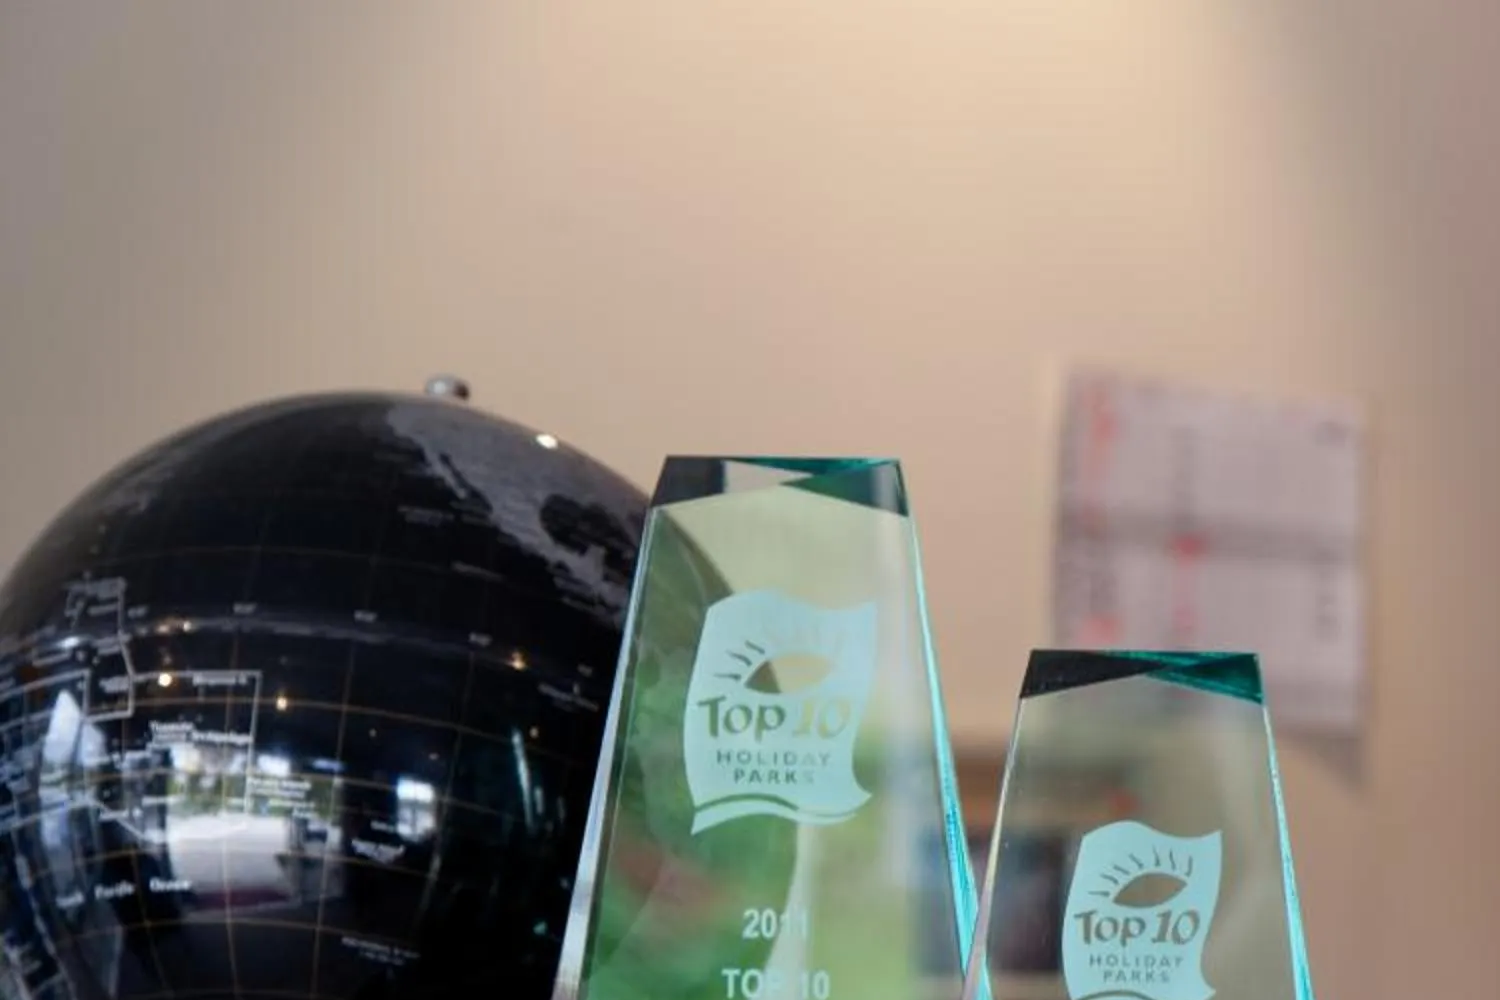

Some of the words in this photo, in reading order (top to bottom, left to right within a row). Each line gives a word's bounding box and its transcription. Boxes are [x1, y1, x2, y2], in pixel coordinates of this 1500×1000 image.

[697, 696, 786, 743] Top
[792, 698, 850, 738] 10
[717, 749, 831, 766] HOLIDAY
[734, 769, 814, 784] PARKS
[1074, 909, 1146, 947] Top
[1151, 909, 1199, 945] 10
[1089, 954, 1184, 968] HOLIDAY
[721, 969, 785, 999] TOP
[1103, 970, 1170, 983] PARKS
